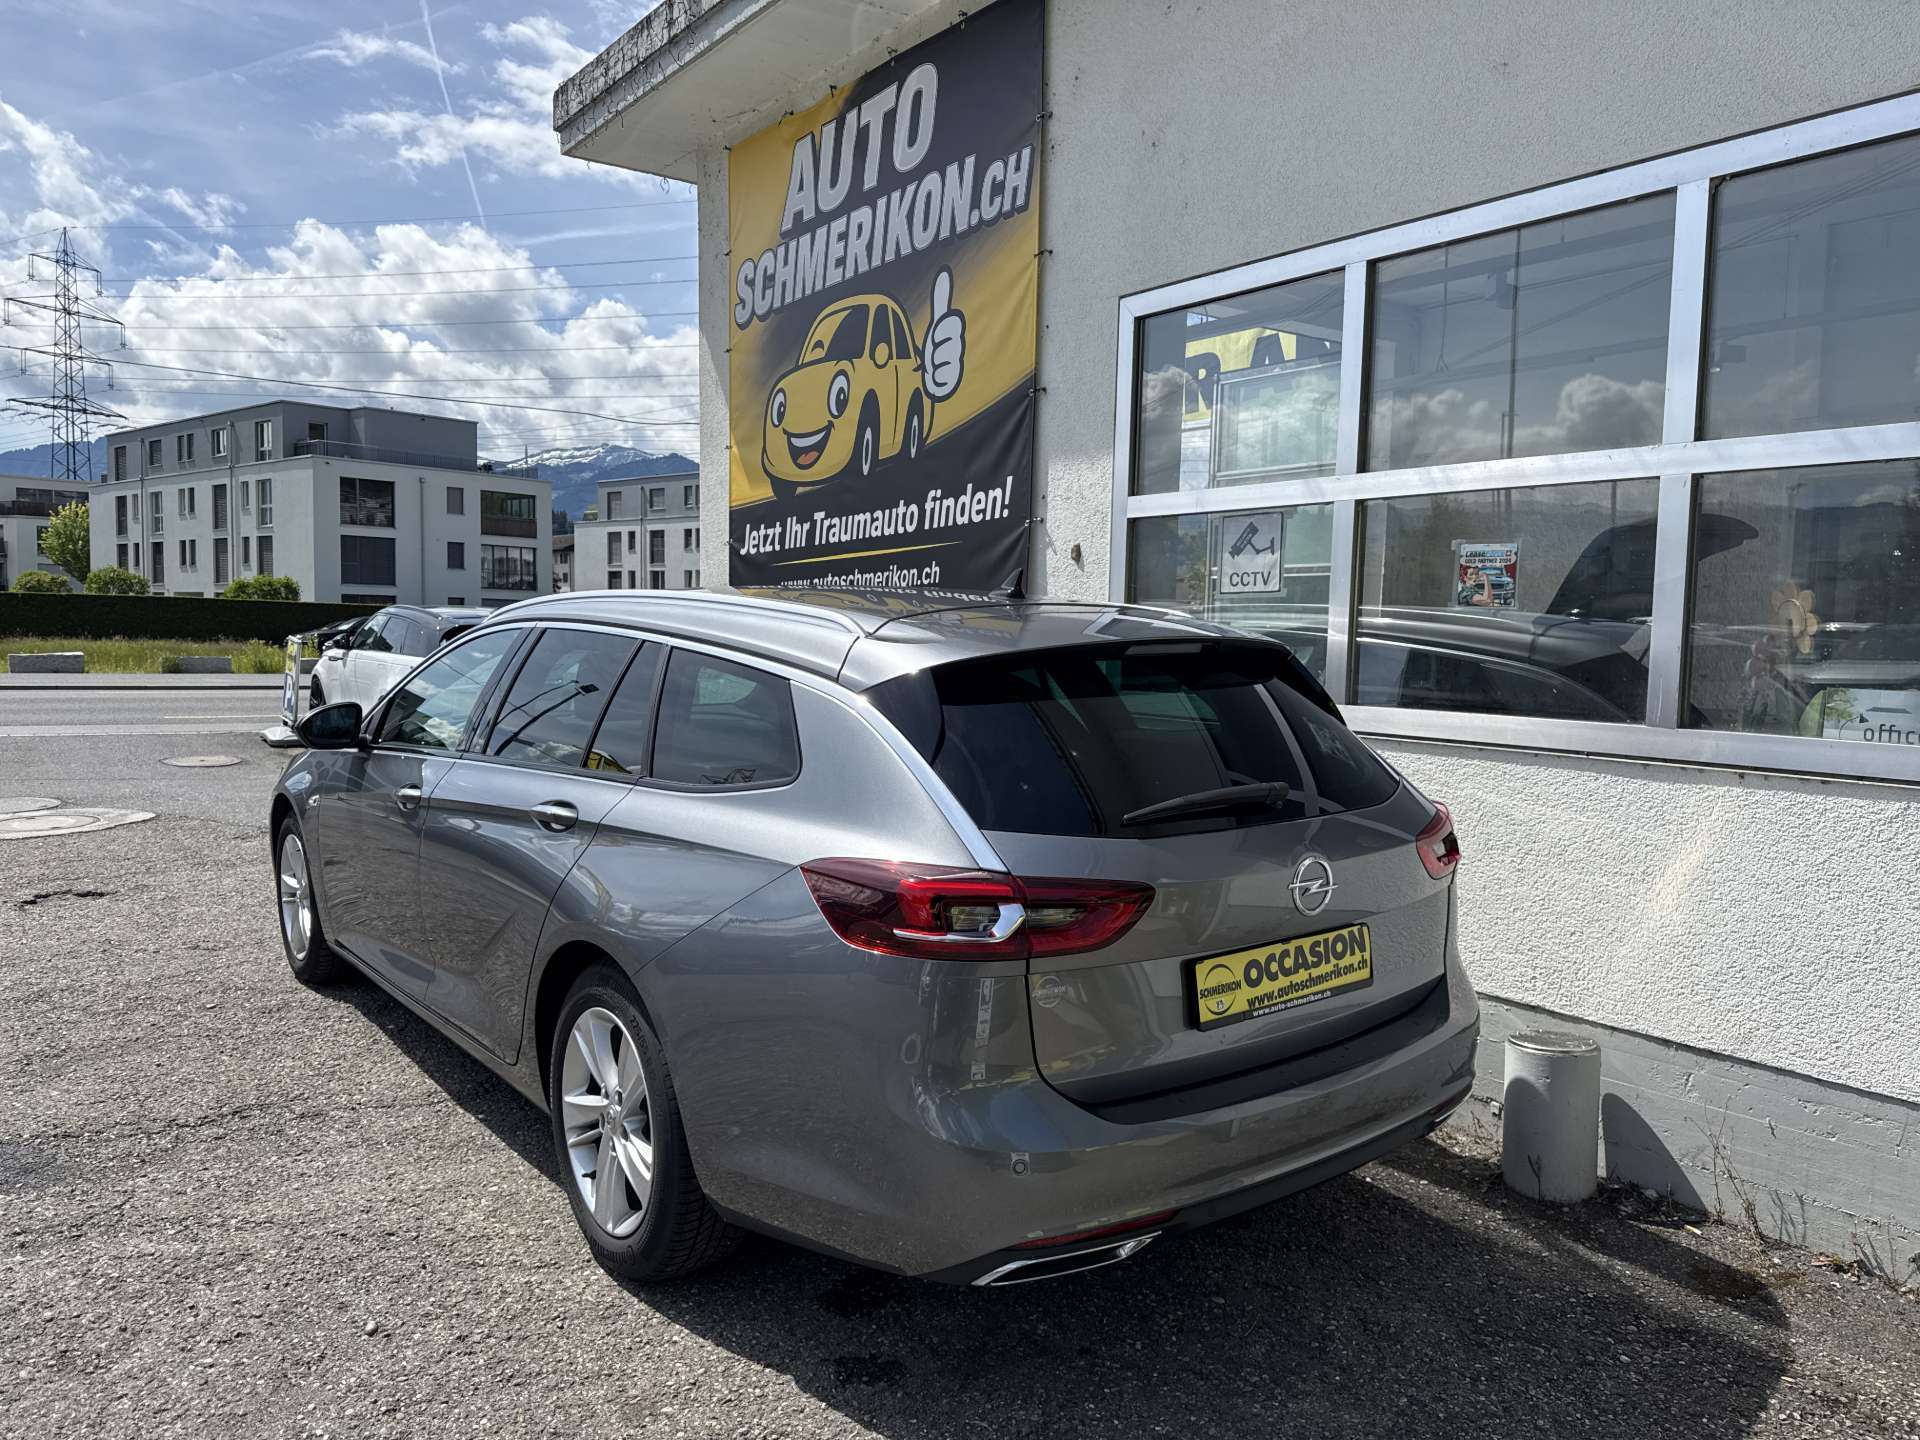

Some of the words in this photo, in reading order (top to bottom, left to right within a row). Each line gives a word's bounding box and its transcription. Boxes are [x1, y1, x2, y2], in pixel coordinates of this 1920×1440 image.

[780, 62, 939, 233] AUTO
[734, 145, 1033, 326] SCHMERIKON.CH
[739, 523, 782, 556] Jetzt
[784, 515, 810, 550] Ihr
[813, 501, 919, 545] Traumauto
[924, 476, 1014, 530] finden!
[1229, 570, 1271, 587] CCTV
[1863, 723, 1920, 745] offic
[1243, 927, 1367, 988] OCCASION
[1246, 955, 1368, 1010] www.autoschmerikon.ch
[1199, 979, 1242, 999] SCHMERIKON
